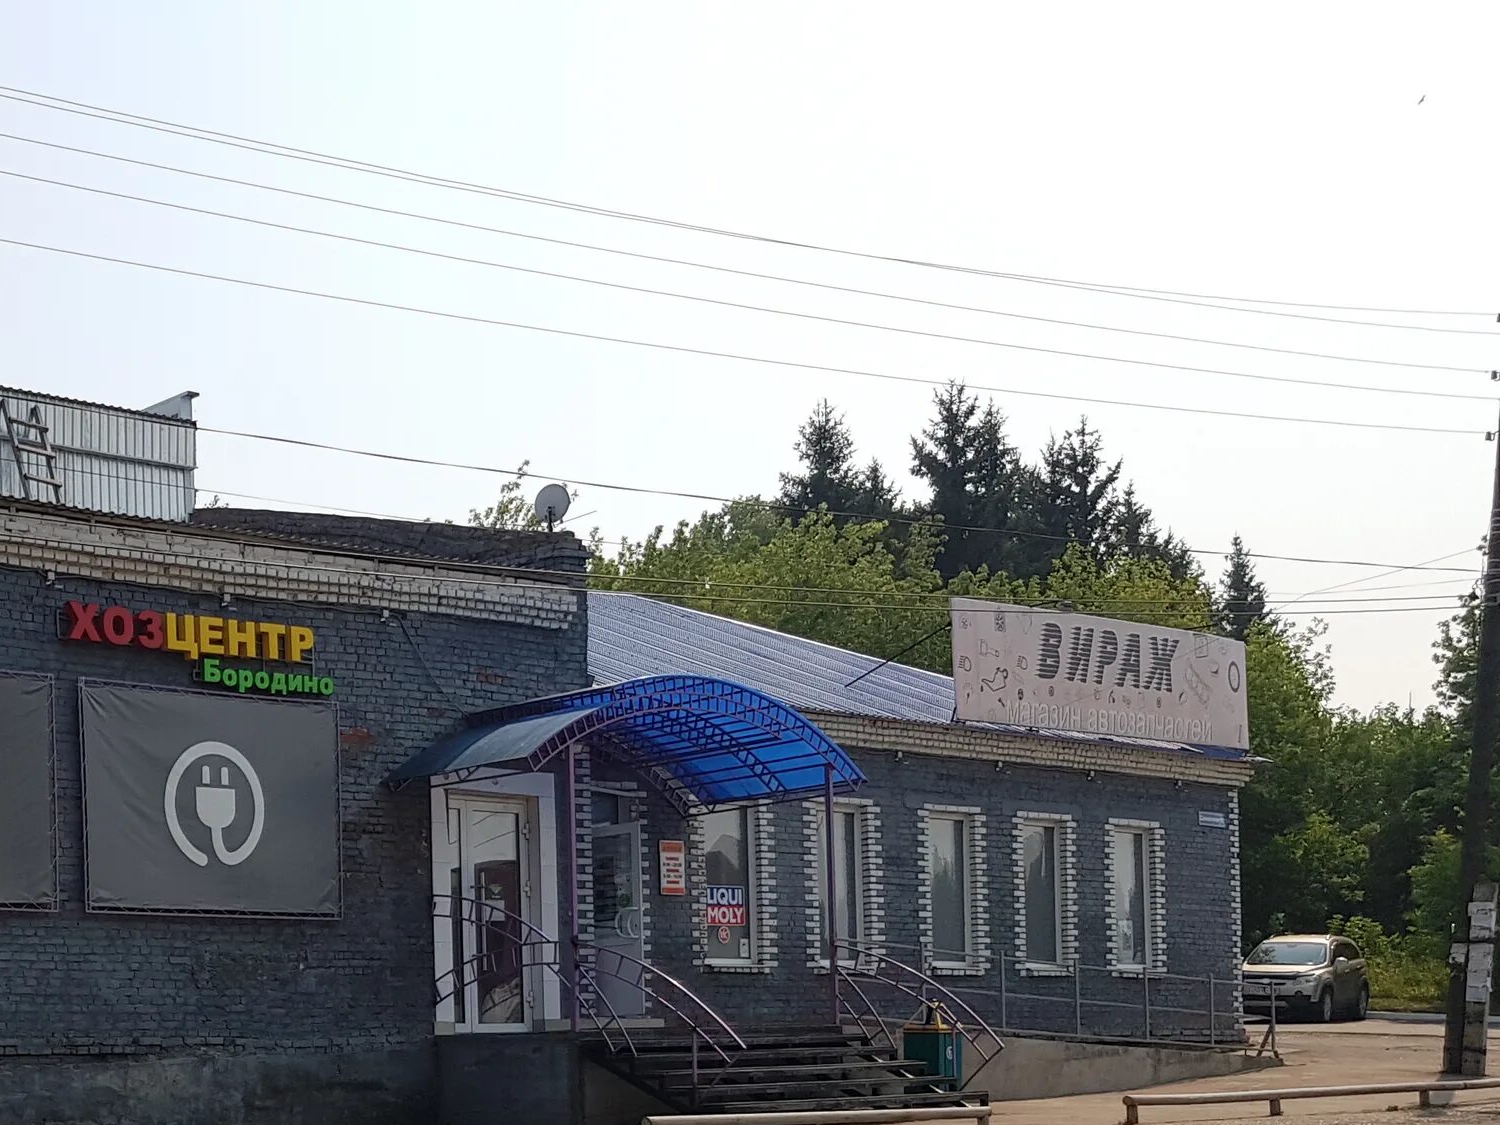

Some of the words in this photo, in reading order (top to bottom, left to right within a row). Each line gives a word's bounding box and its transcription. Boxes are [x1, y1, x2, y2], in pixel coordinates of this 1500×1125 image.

[66, 601, 315, 661] ХОЗЦЕНТР
[1035, 622, 1180, 693] ВИРАЖ
[203, 658, 334, 695] Бородино
[1088, 708, 1213, 741] автозапчастей
[707, 888, 743, 905] LIQUI
[707, 907, 744, 924] MOLY
